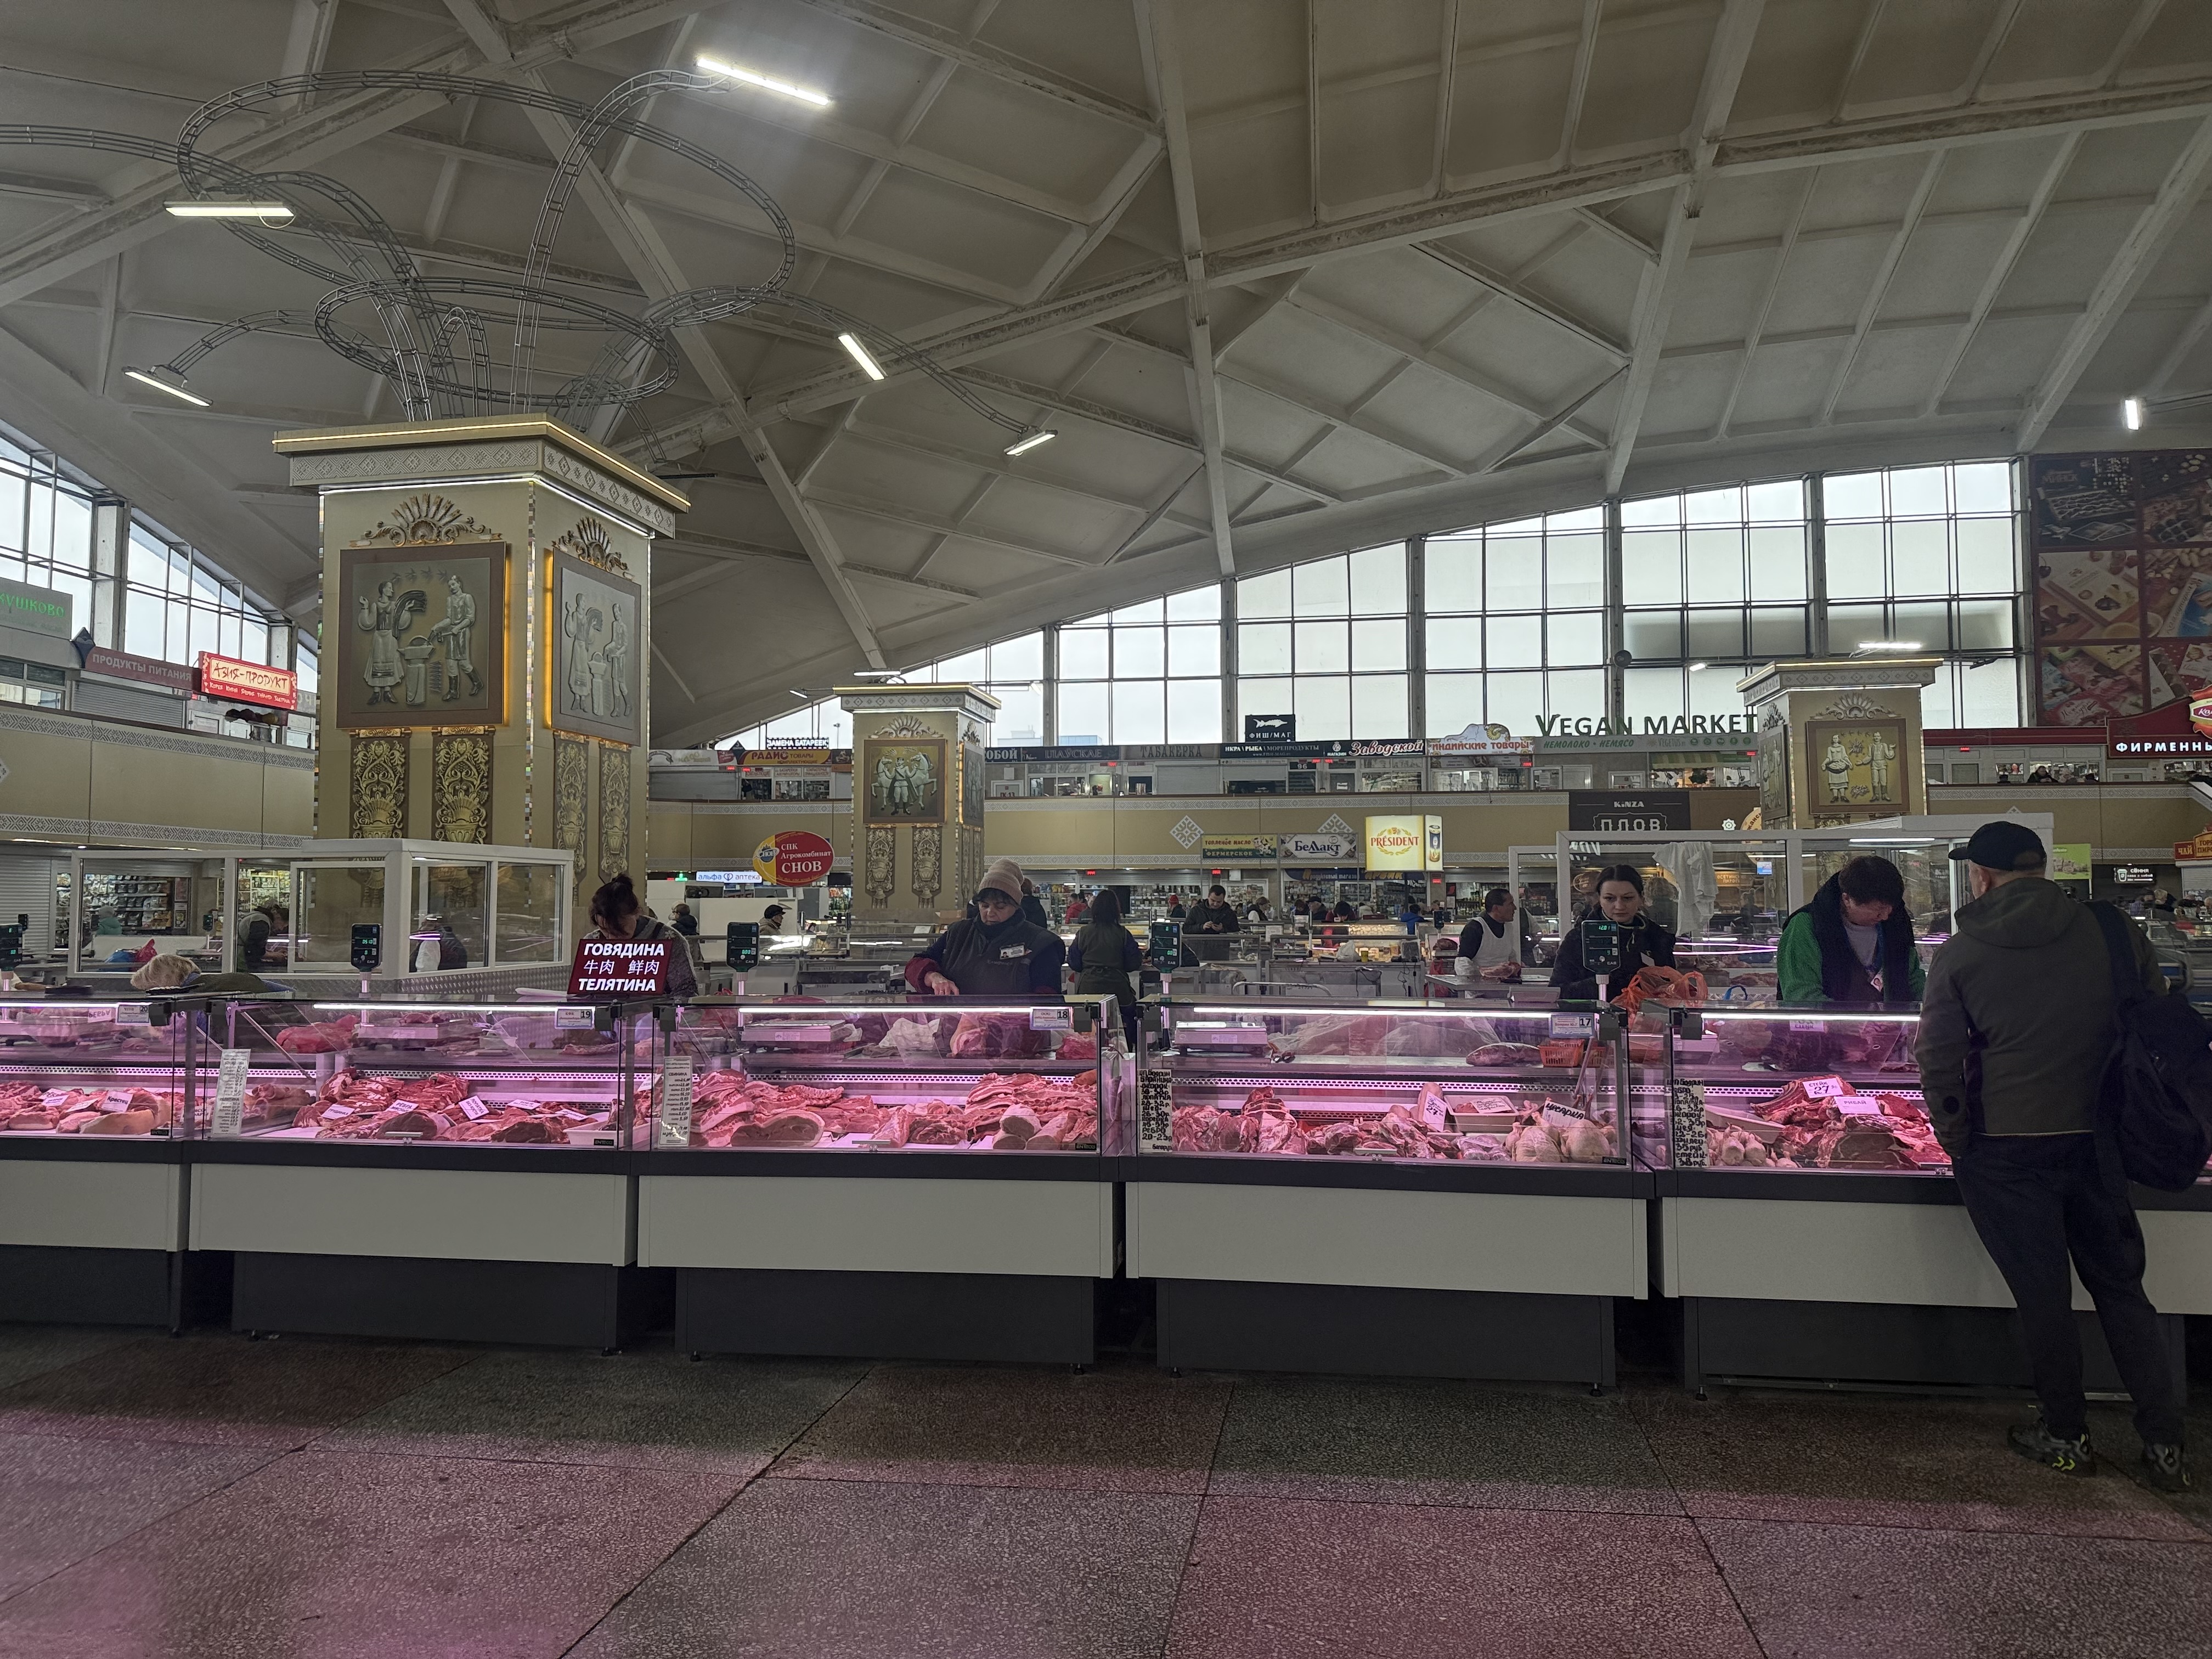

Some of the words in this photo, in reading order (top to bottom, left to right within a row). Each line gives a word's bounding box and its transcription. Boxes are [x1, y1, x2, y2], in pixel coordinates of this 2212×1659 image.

[92, 654, 146, 673] ПРОДУКТЫ
[148, 665, 191, 682] ПИТАНИЯ
[1536, 714, 1633, 737] VEGAN
[1645, 714, 1758, 736] MARKET
[1348, 740, 1424, 757] Заводской
[1543, 740, 1590, 749] НЕМОЛОКО
[1599, 739, 1634, 748] НЕМЯСО
[752, 751, 788, 760] РАДИО
[1140, 746, 1203, 758] ТАБАКЕРКА
[1370, 835, 1420, 848] PRÉSIDENT
[780, 850, 832, 860] Агрокомбинат
[2178, 845, 2193, 855] ЧАЙ
[781, 861, 822, 873] СНОВ
[584, 944, 664, 958] ГОВЯДИНА
[584, 959, 615, 975] 牛肉
[627, 960, 659, 975] 鲜肉
[578, 978, 656, 991] ТЕЛЯТИНА
[1058, 1011, 1068, 1019] 18
[1579, 1018, 1591, 1026] 17
[1814, 1085, 1830, 1095] 27
[107, 1096, 129, 1105] Крестец
